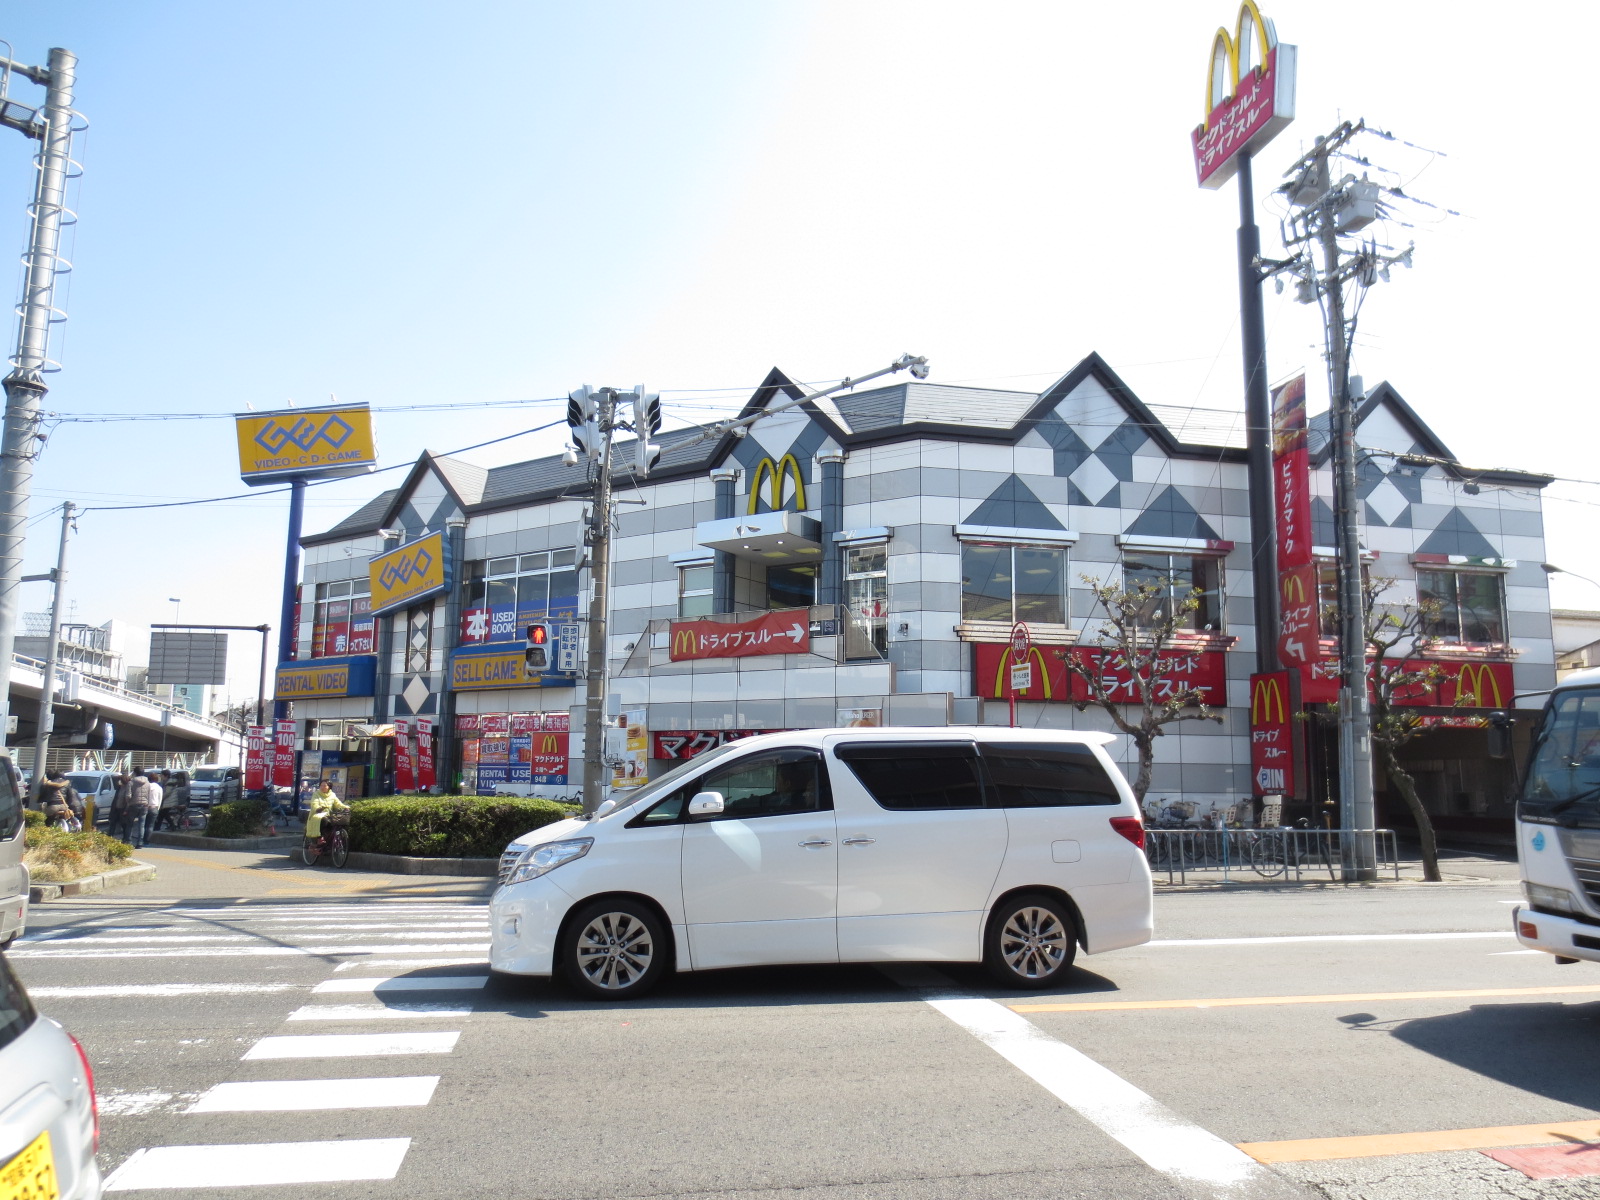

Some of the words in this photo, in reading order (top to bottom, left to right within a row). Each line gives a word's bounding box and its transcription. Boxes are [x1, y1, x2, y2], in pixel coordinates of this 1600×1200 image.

[1197, 80, 1262, 150] マクドナルド
[1198, 98, 1270, 175] ドライブスルー
[254, 457, 291, 469] VIDEO
[327, 450, 362, 461] GAME
[1282, 459, 1294, 555] ビッグマック
[492, 611, 515, 623] USED
[700, 629, 786, 650] ドライブスルー
[455, 663, 482, 684] SELL
[484, 660, 517, 682] GAME
[278, 675, 314, 693] RENTAL
[317, 672, 347, 690] VIDEO
[249, 738, 264, 750] 100
[278, 733, 294, 746] 100
[419, 733, 431, 748] 100
[1253, 729, 1280, 743] ドライブ
[534, 755, 565, 763] マクドナルド
[1264, 747, 1287, 758] スルー
[480, 769, 507, 778] RENTAL
[1270, 768, 1285, 789] IN
